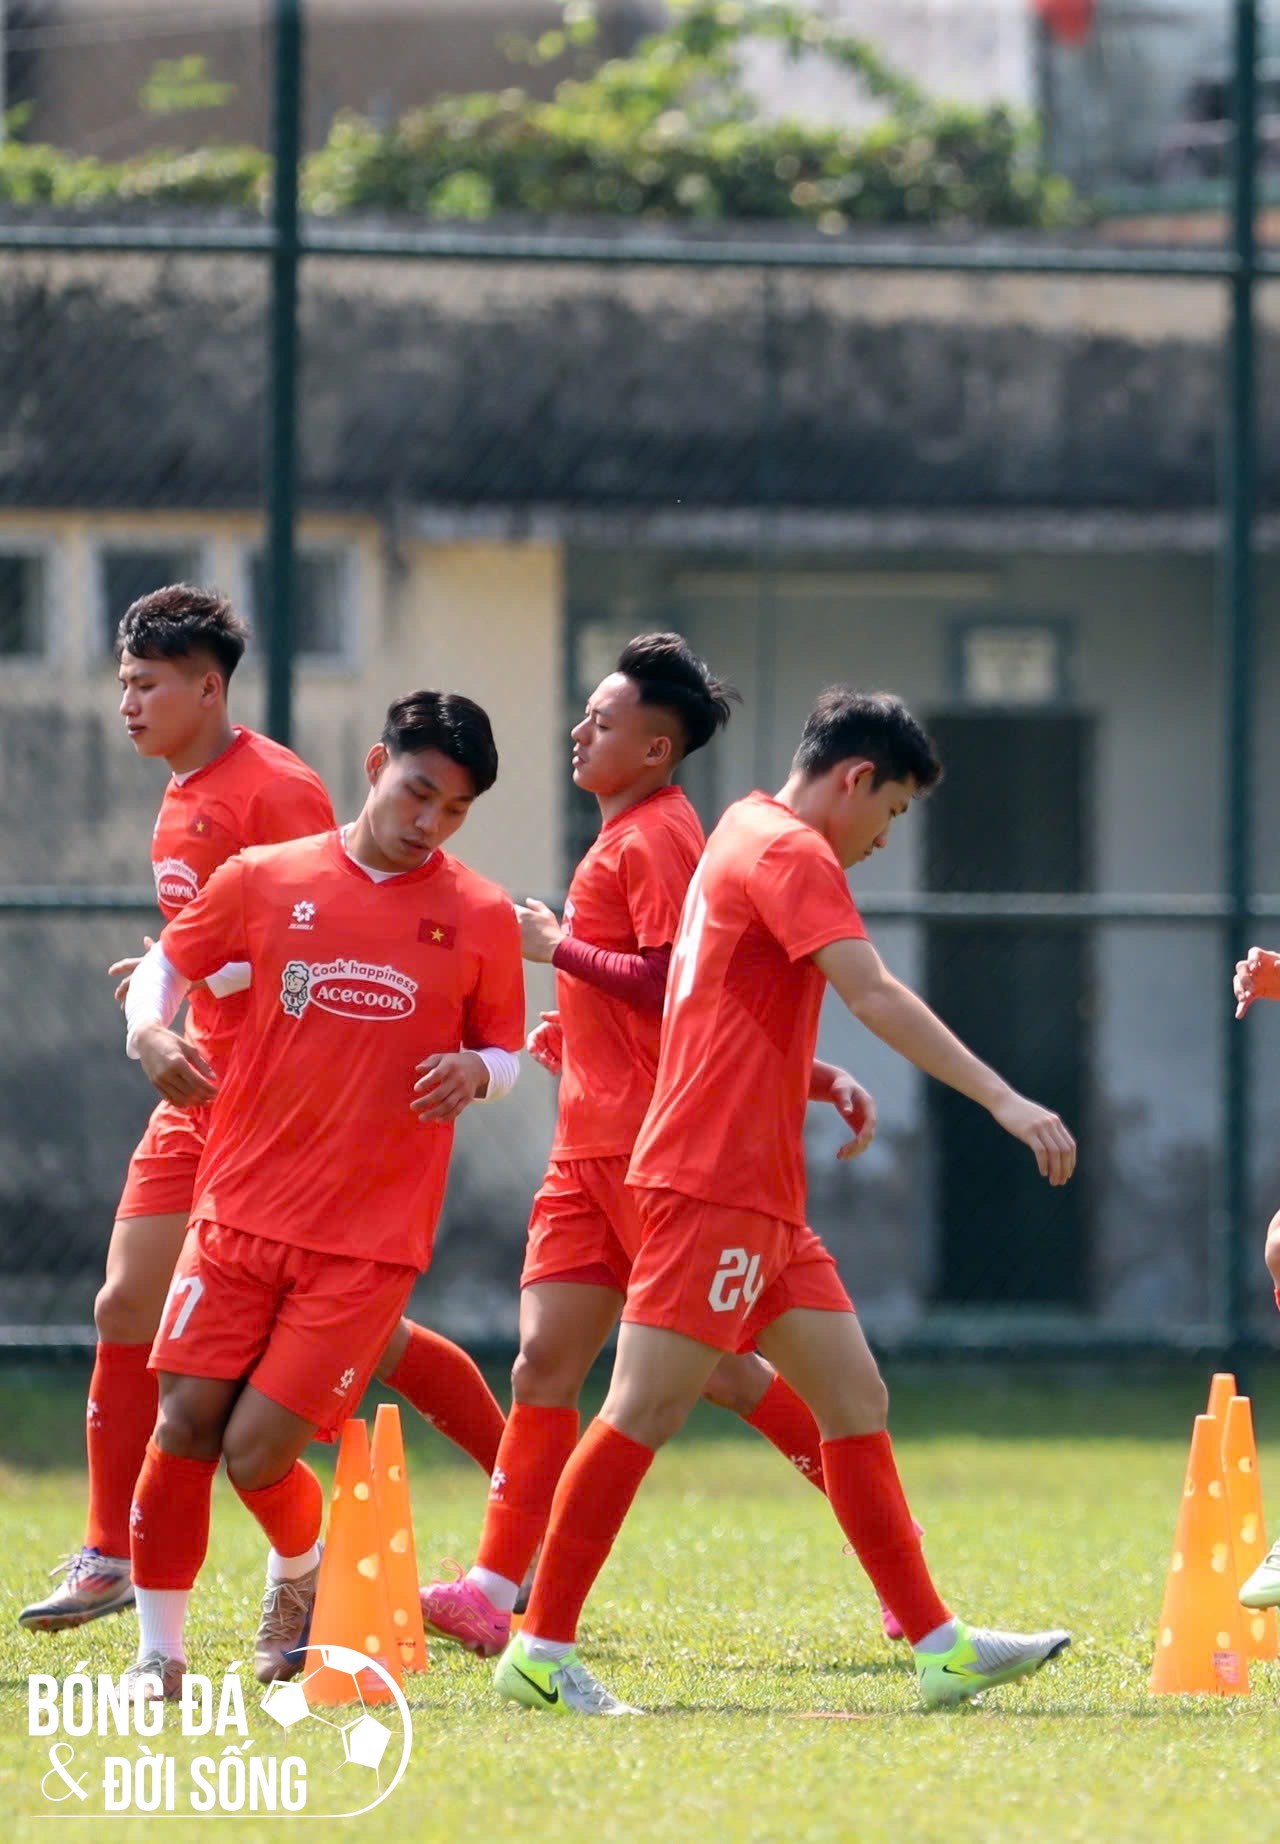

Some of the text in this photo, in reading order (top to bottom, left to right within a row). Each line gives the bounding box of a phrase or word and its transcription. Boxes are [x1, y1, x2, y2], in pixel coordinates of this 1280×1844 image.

[311, 962, 416, 992] Cook happiness
[708, 1248, 764, 1320] 24
